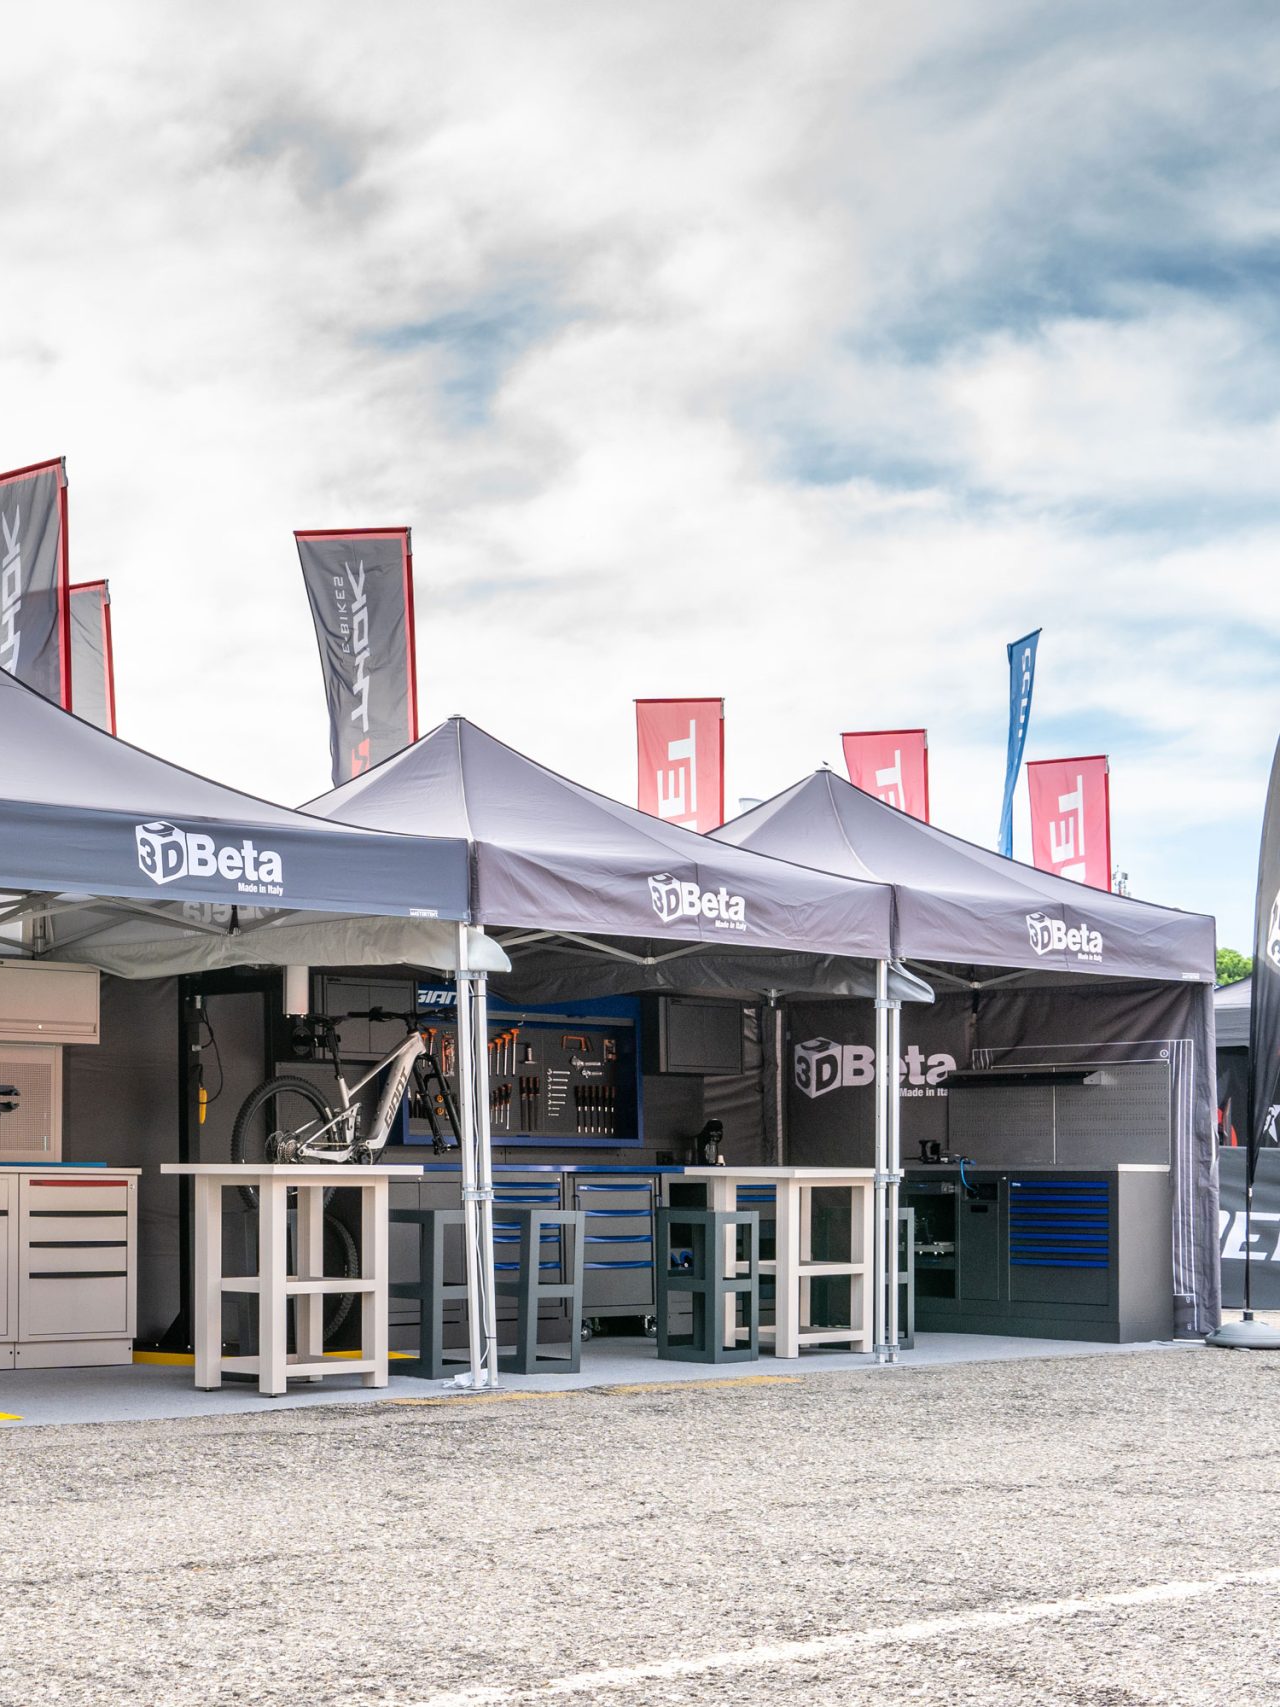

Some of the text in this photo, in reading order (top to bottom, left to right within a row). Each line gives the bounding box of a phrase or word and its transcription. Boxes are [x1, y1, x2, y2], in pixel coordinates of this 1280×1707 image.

[238, 882, 284, 897] Made in Italy
[385, 1067, 407, 1129] GIANT
[899, 1087, 948, 1097] Made in Ita
